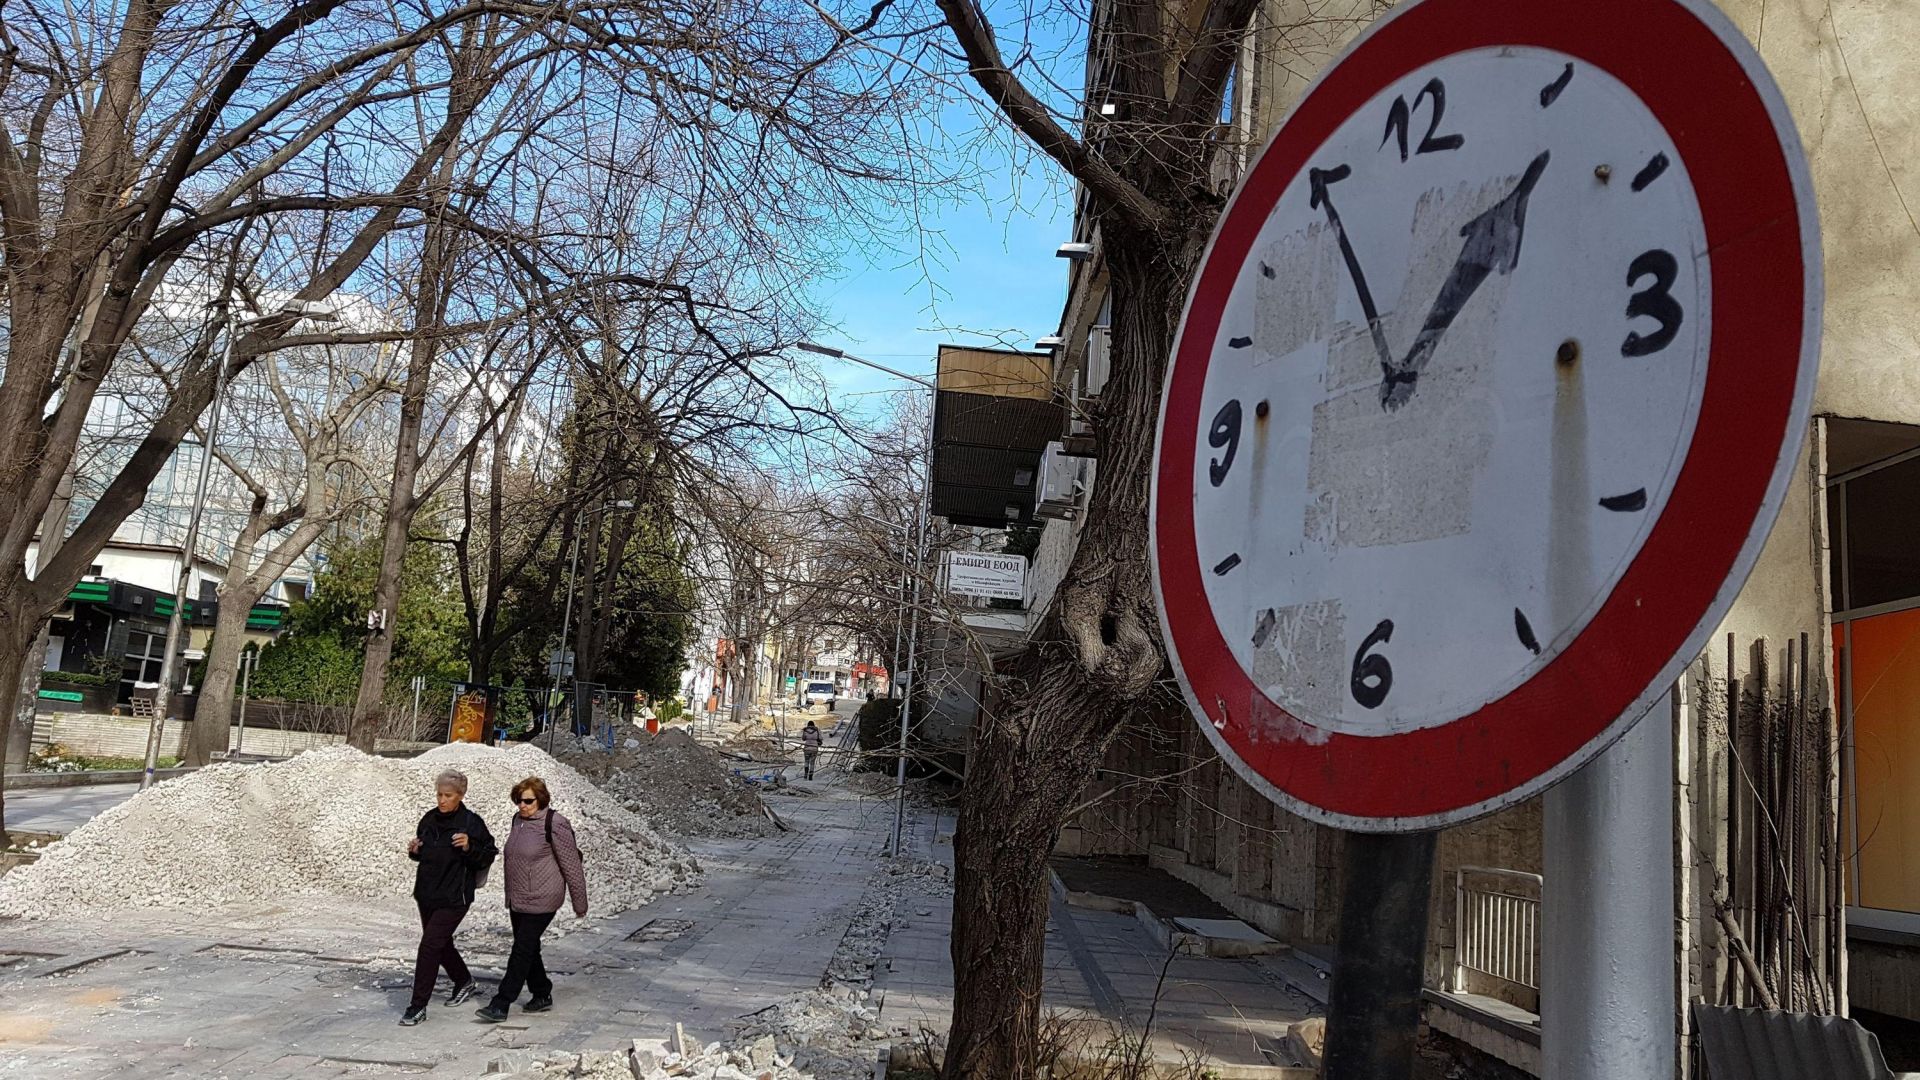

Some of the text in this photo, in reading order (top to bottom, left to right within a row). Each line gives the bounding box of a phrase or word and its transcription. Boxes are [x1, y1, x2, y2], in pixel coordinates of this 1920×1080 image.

[1377, 77, 1465, 164] 12
[1621, 249, 1683, 357] 3
[1209, 399, 1242, 487] 9
[993, 560, 1020, 573] ЕООД
[1351, 619, 1394, 709] 6
